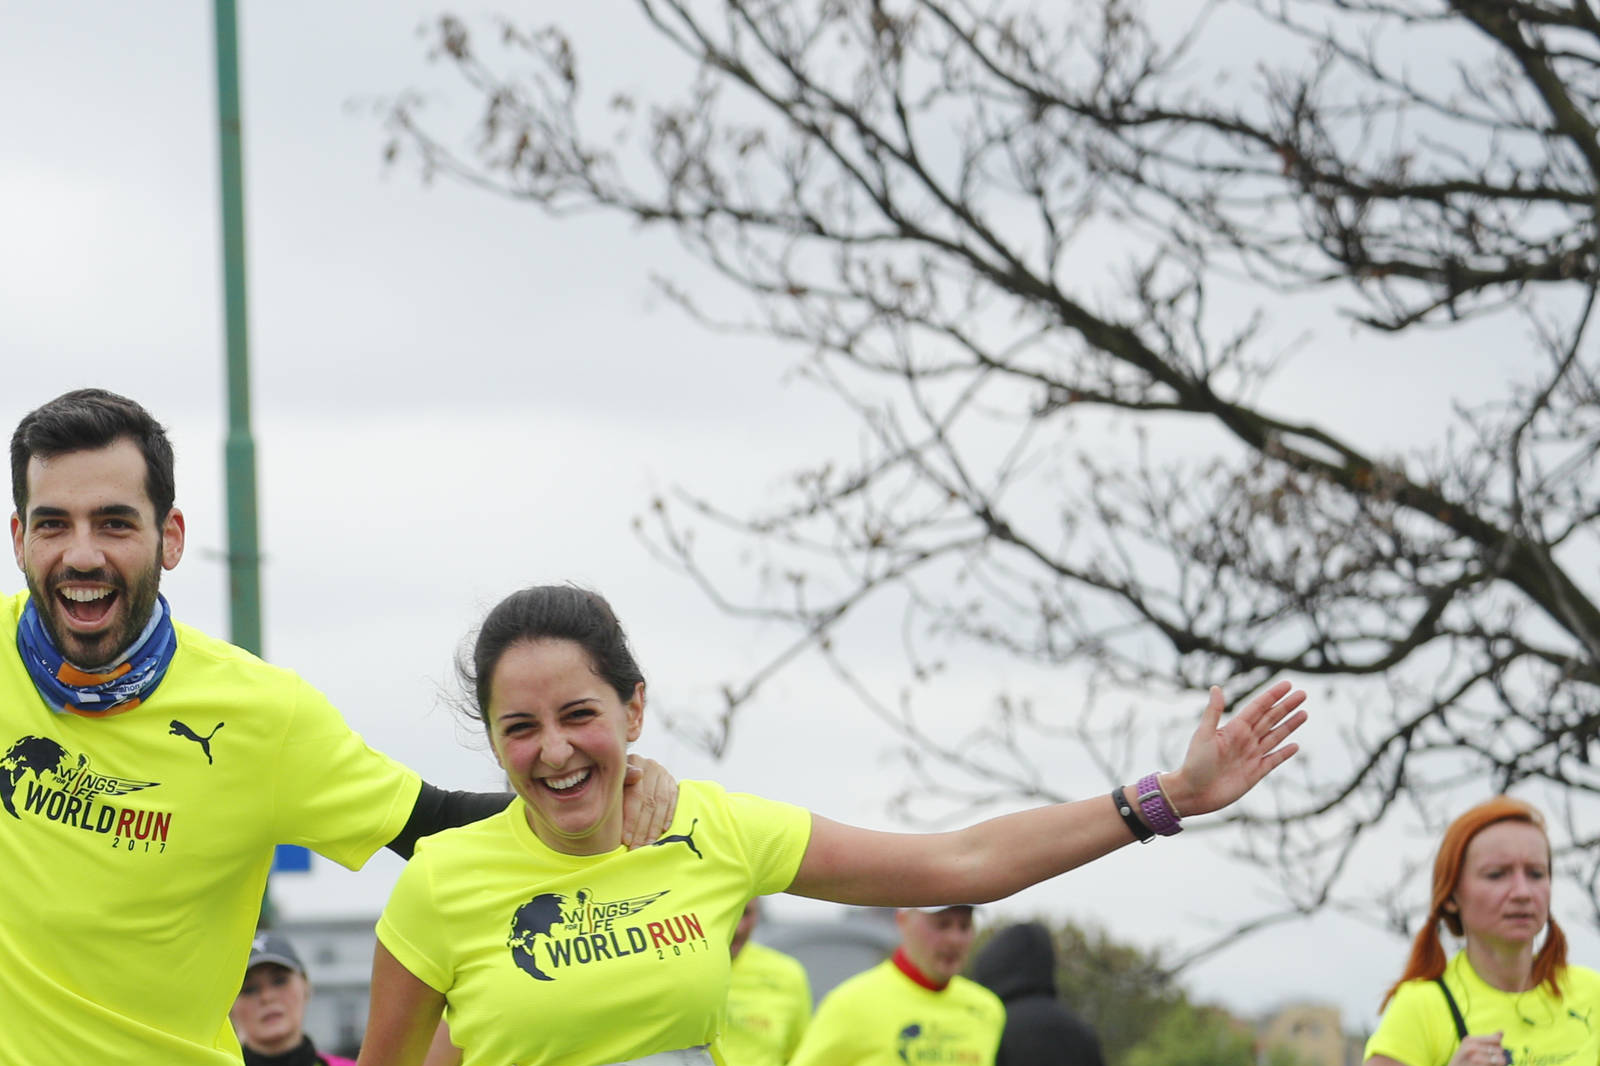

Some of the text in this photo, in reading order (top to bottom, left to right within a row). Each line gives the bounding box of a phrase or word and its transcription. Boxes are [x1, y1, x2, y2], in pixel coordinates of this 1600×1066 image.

[53, 776, 100, 801] FOR LIFE
[59, 765, 119, 793] WINGS
[112, 837, 166, 853] 2017
[564, 902, 629, 924] WINGS
[564, 917, 614, 935] FOR LIFE
[656, 939, 709, 961] 2017
